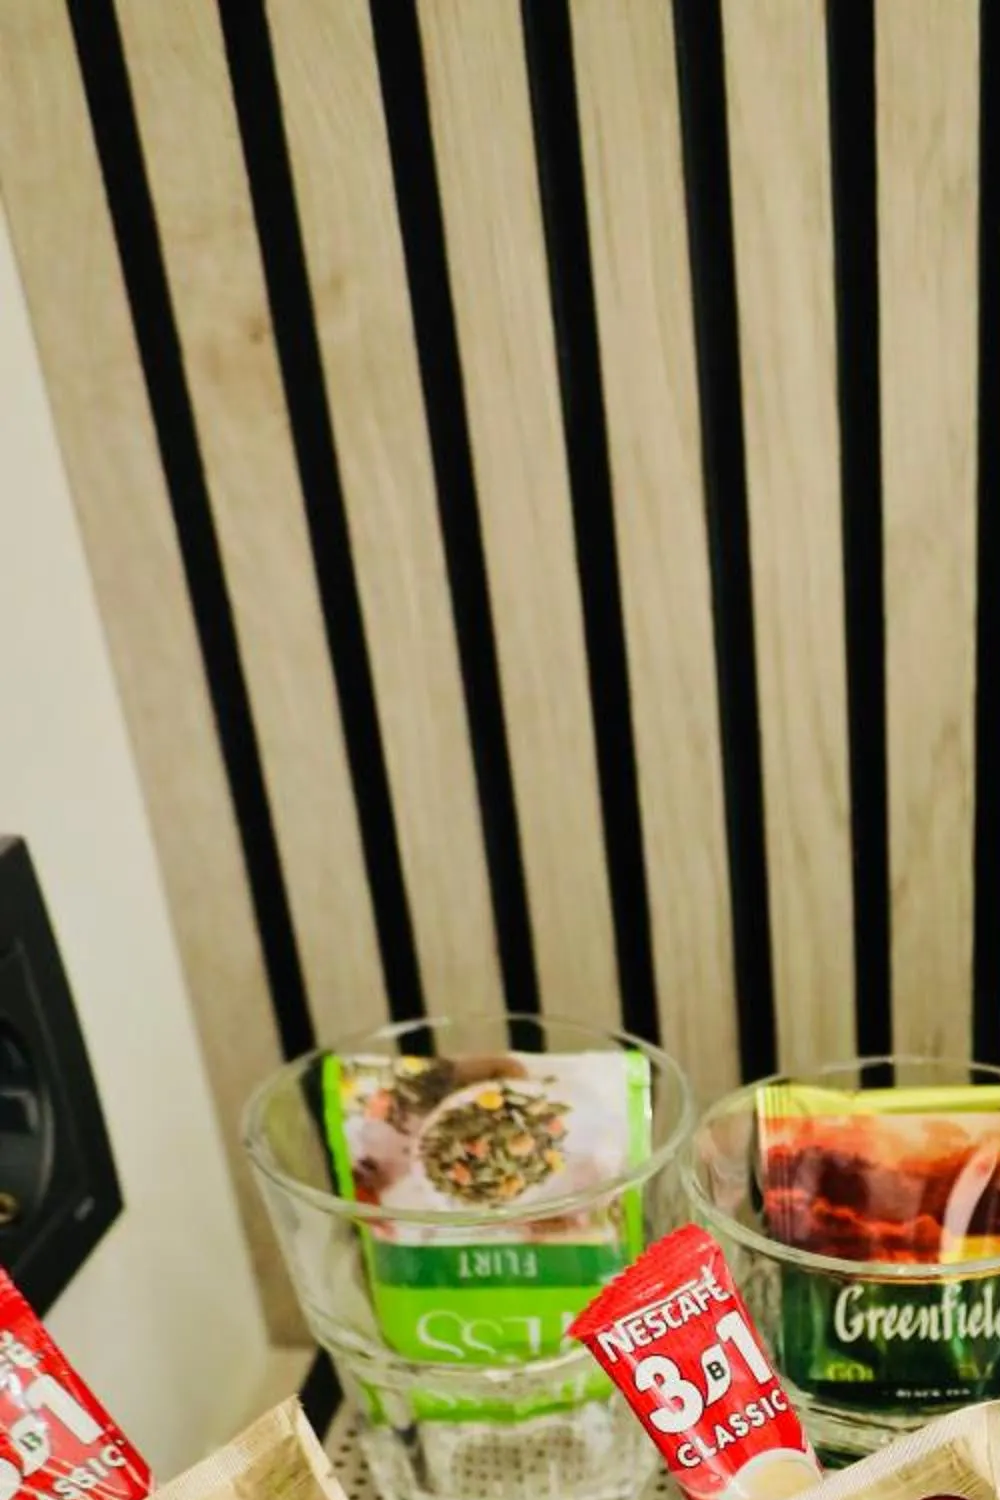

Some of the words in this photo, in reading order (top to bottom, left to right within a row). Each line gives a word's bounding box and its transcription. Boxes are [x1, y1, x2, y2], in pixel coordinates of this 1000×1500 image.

[457, 1250, 538, 1278] FLIRT
[635, 1354, 704, 1434] 3
[716, 1310, 772, 1385] 1
[676, 1389, 789, 1468] CLASSIC
